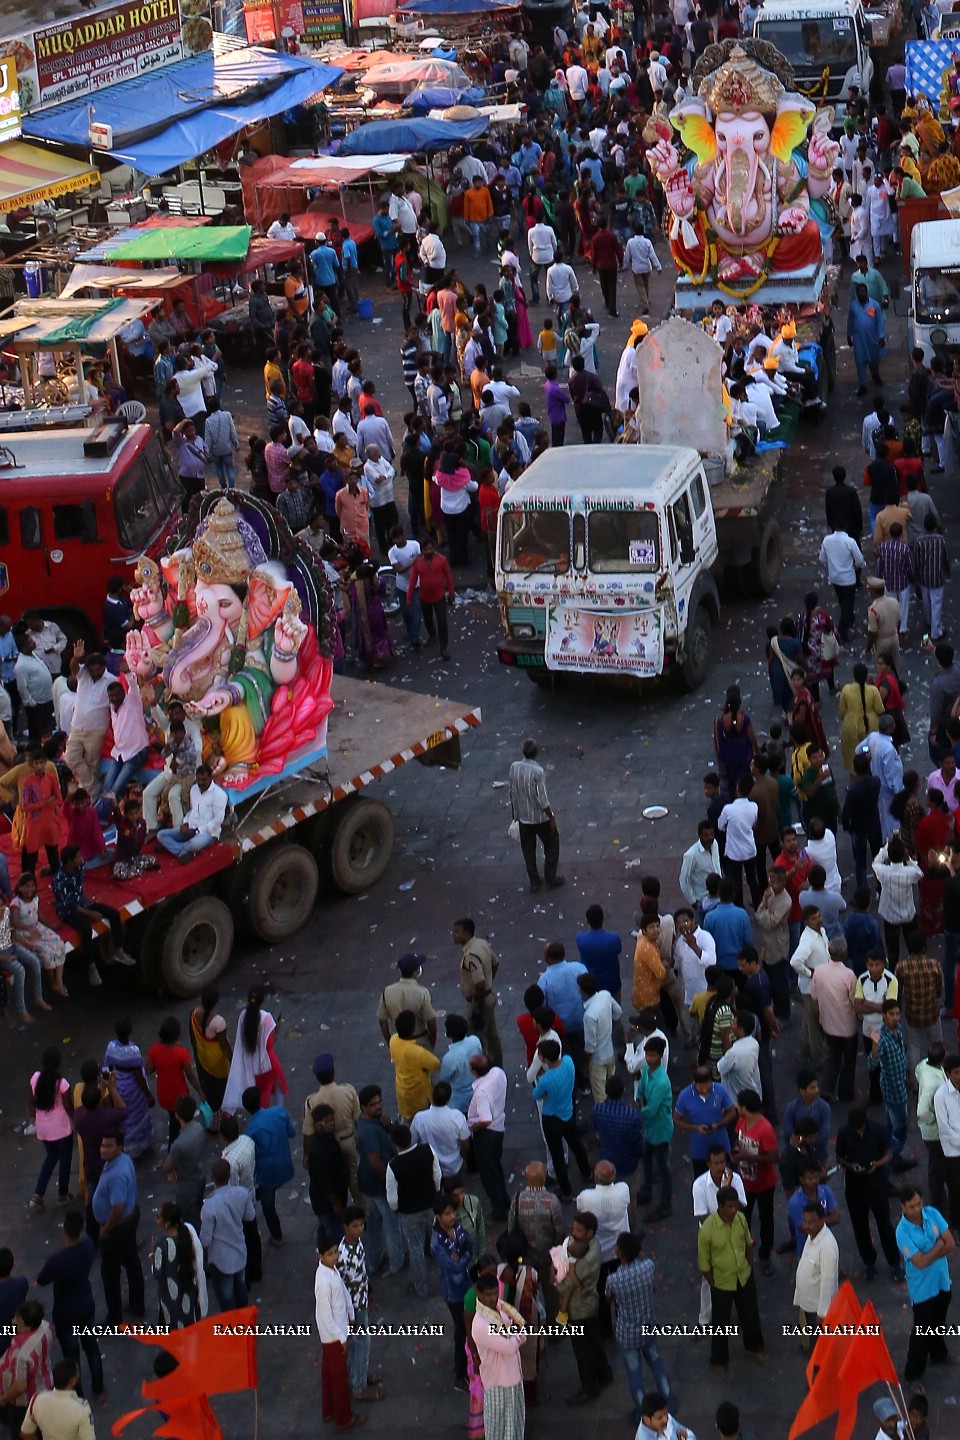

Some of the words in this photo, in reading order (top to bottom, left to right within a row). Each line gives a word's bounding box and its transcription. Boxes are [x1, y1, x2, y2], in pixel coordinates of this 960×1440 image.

[306, 7, 318, 15] DAL
[319, 6, 334, 14] RICE
[38, 12, 126, 59] MUQADDAR
[111, 30, 145, 52] CHICKEN
[149, 20, 178, 37] BIRYANI
[52, 70, 67, 83] SPL.
[67, 61, 94, 77] TAHARI,
[95, 52, 120, 68] BAGARA
[121, 44, 144, 61] KHANA
[145, 37, 170, 52] DALCHA
[8, 196, 24, 208] PAN
[25, 190, 46, 203] SHOP
